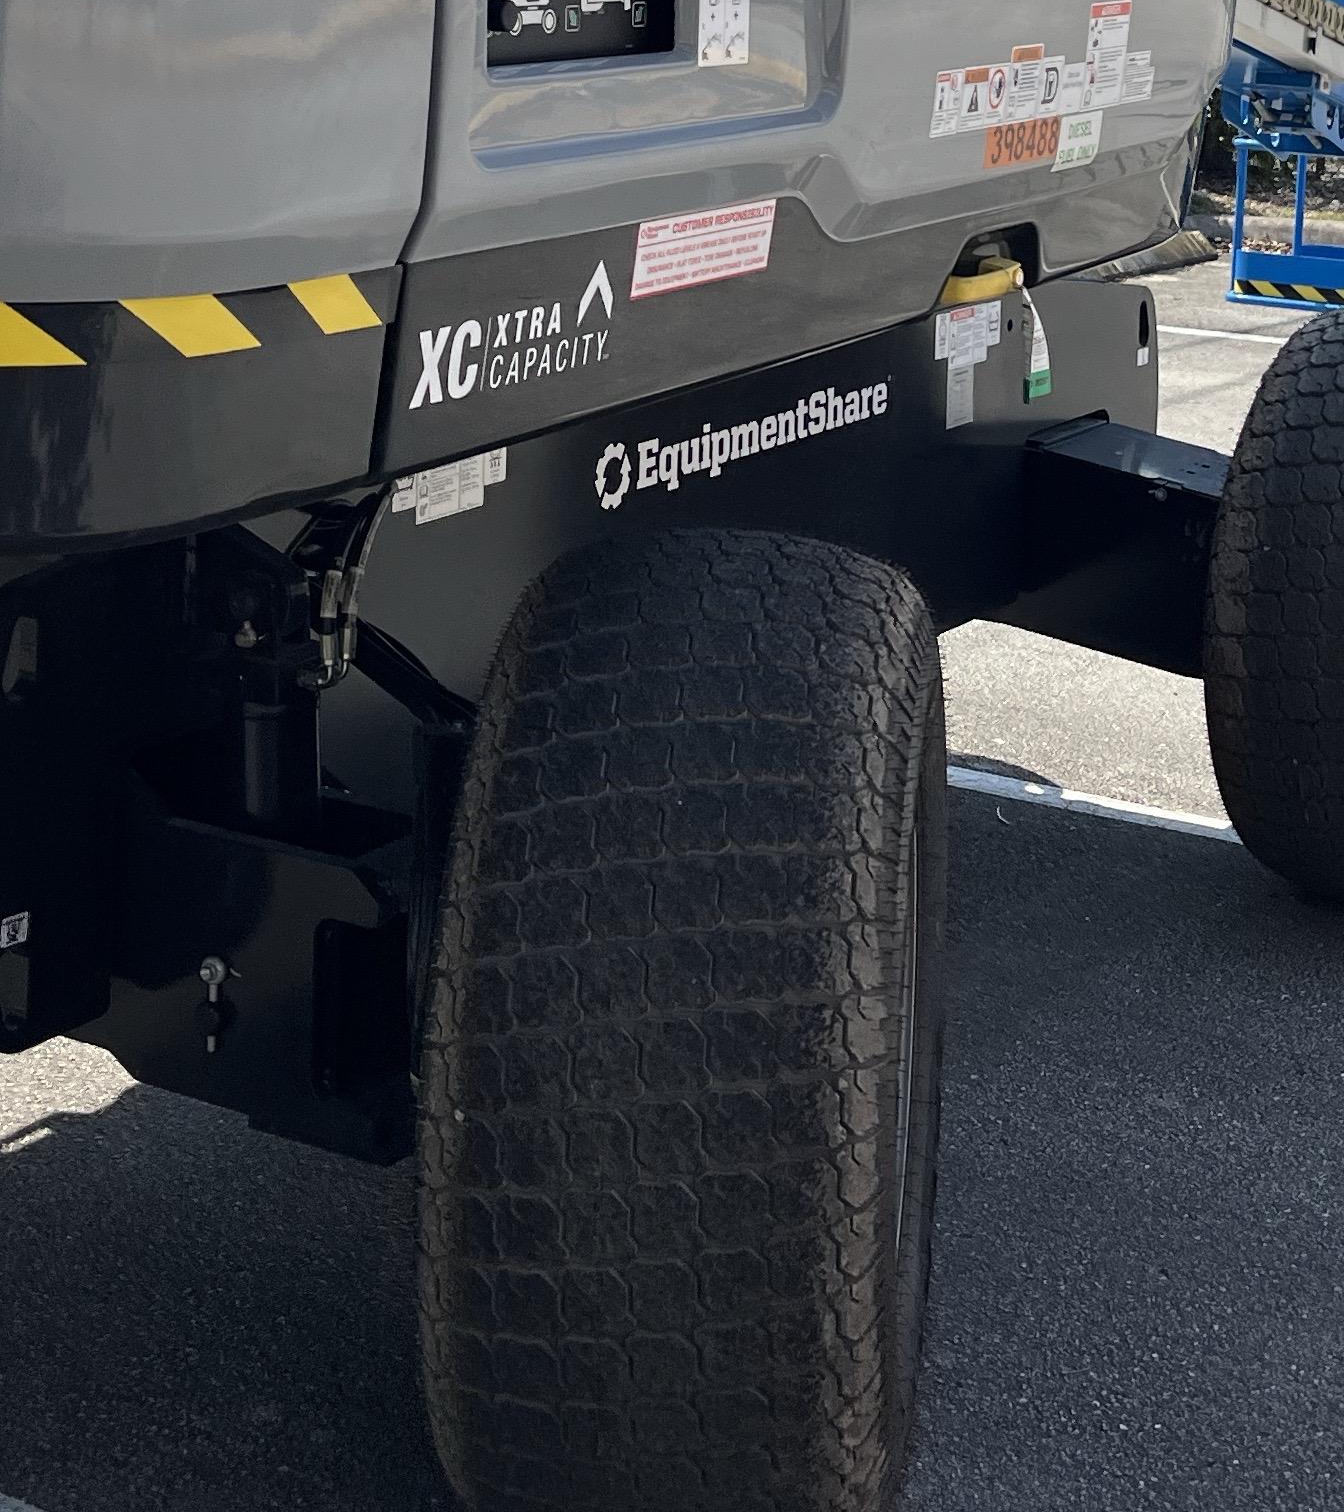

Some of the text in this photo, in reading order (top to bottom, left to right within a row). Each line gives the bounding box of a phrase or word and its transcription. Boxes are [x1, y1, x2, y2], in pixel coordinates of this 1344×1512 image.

[991, 116, 1059, 164] 398488
[494, 302, 561, 348] XTRA
[409, 319, 482, 410] XC
[489, 329, 608, 389] CAPACITY
[636, 382, 888, 491] EquipmentShare
